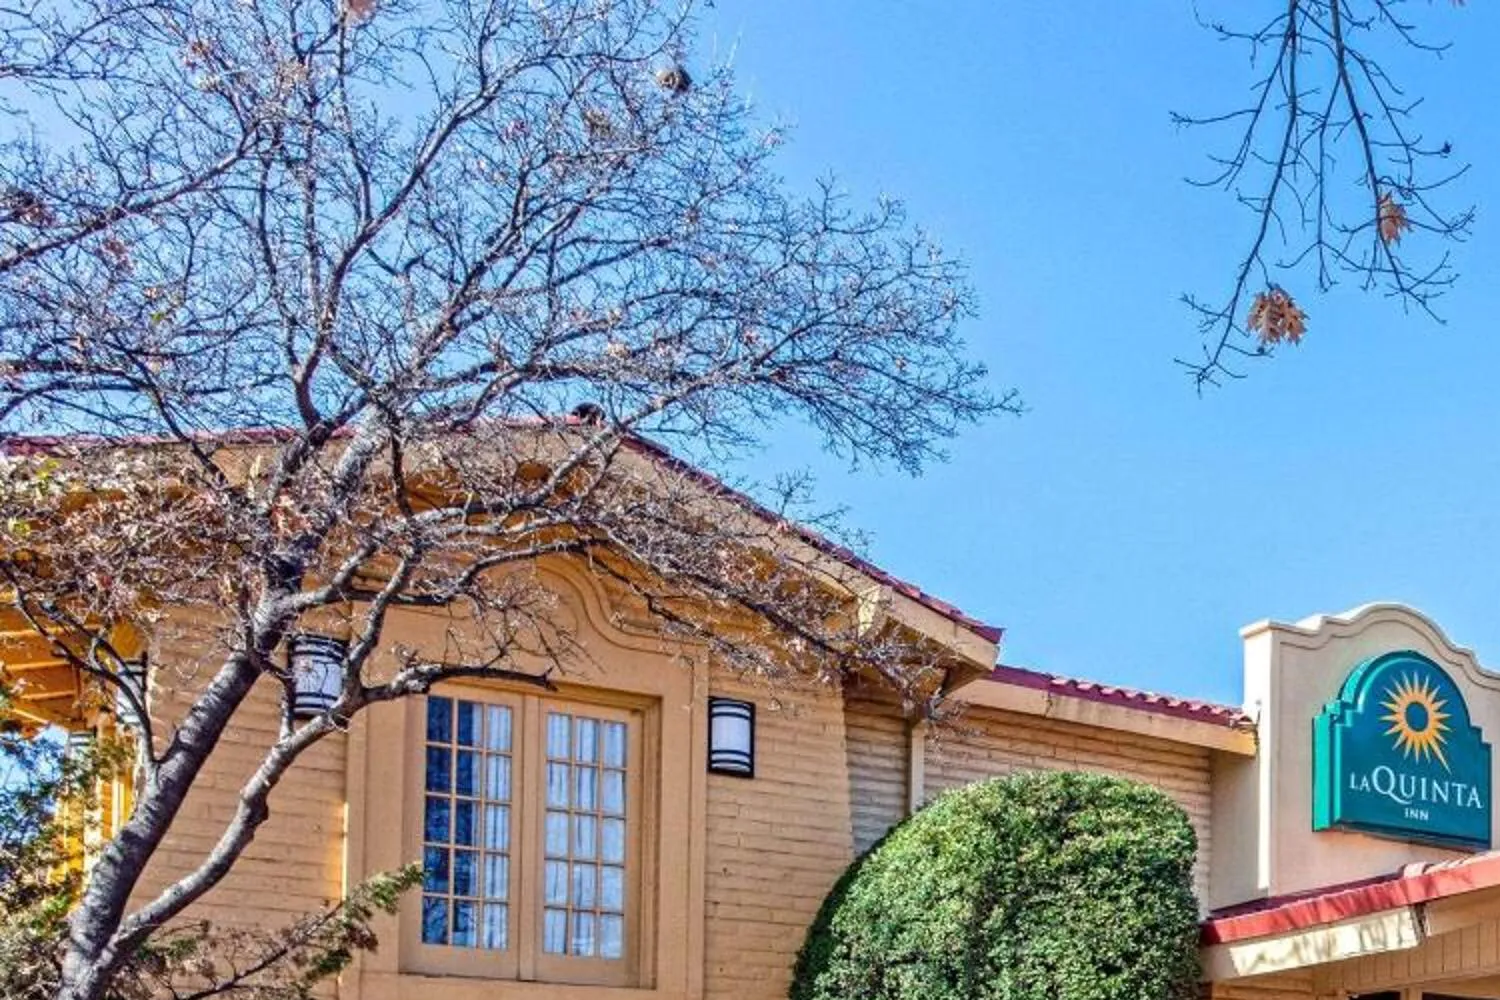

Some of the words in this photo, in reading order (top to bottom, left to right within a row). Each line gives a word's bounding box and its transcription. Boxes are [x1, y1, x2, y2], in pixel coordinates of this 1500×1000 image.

[1349, 772, 1371, 793] LA
[1371, 765, 1484, 809] QUINTA
[1404, 807, 1430, 821] INN
